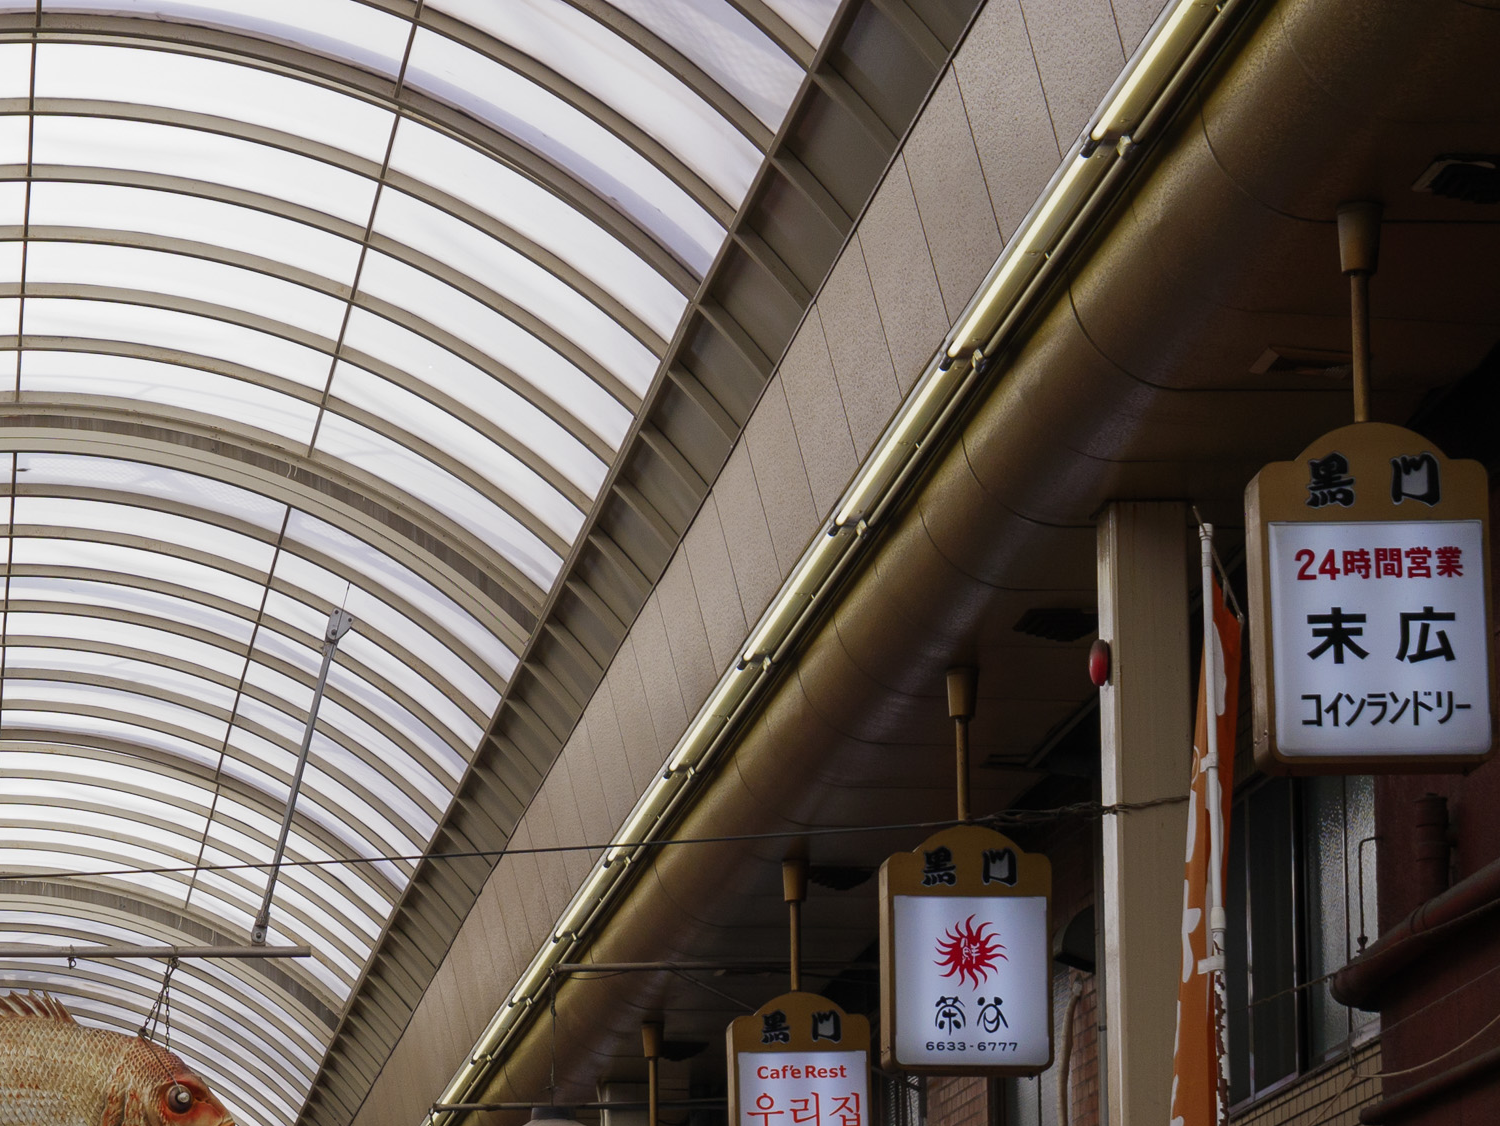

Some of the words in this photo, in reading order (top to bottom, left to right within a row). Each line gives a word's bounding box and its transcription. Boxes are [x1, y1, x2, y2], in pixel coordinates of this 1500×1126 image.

[1306, 452, 1441, 508] 黒門
[1294, 546, 1463, 580] 24時間営業
[1307, 606, 1456, 664] 末広
[1301, 691, 1471, 727] コインランドリー
[921, 846, 1018, 886] 黒門
[761, 1009, 842, 1044] 黒門
[926, 1042, 1018, 1051] 6633-6777
[805, 1064, 847, 1079] Rest
